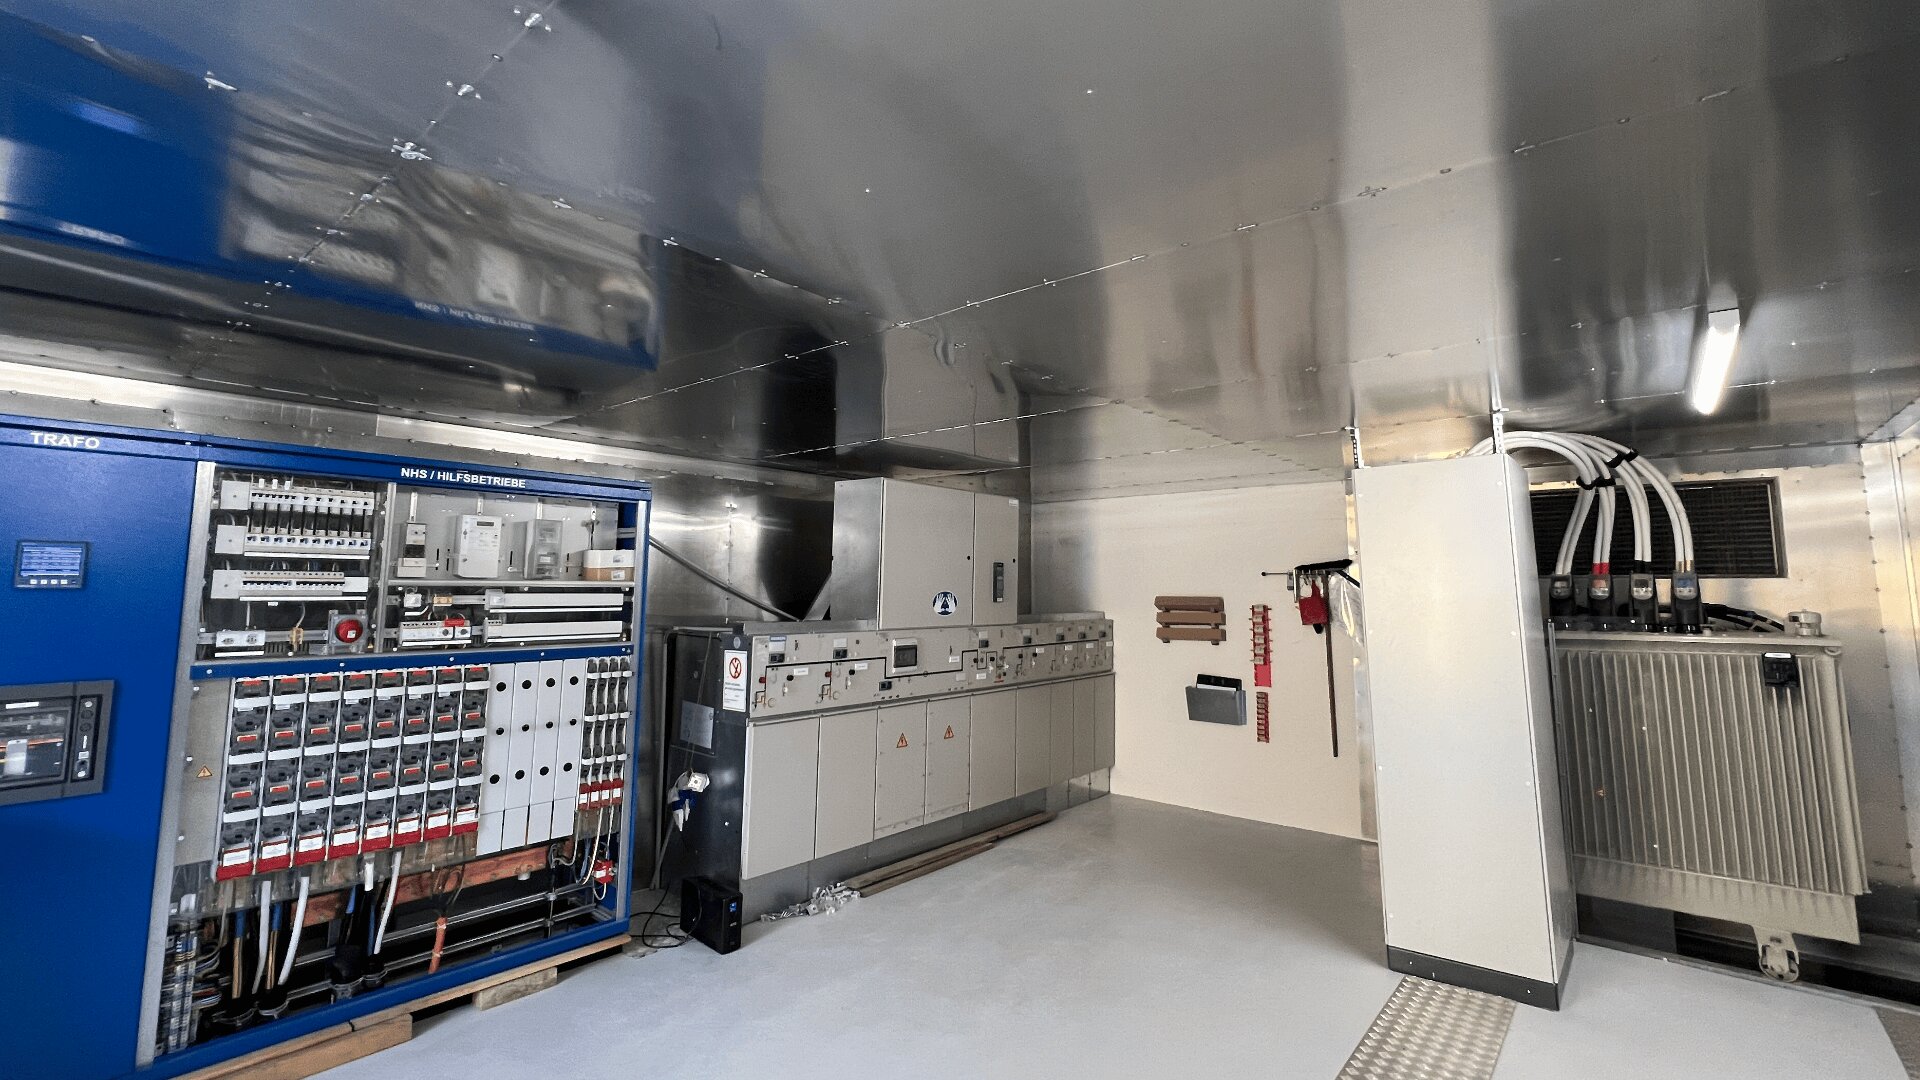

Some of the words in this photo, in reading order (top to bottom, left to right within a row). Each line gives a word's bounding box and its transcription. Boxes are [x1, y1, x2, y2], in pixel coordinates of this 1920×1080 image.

[30, 431, 100, 449] TRAFO
[400, 467, 427, 479] NHS
[429, 470, 436, 480] /
[437, 471, 526, 488] HILFSBETRIEBE
